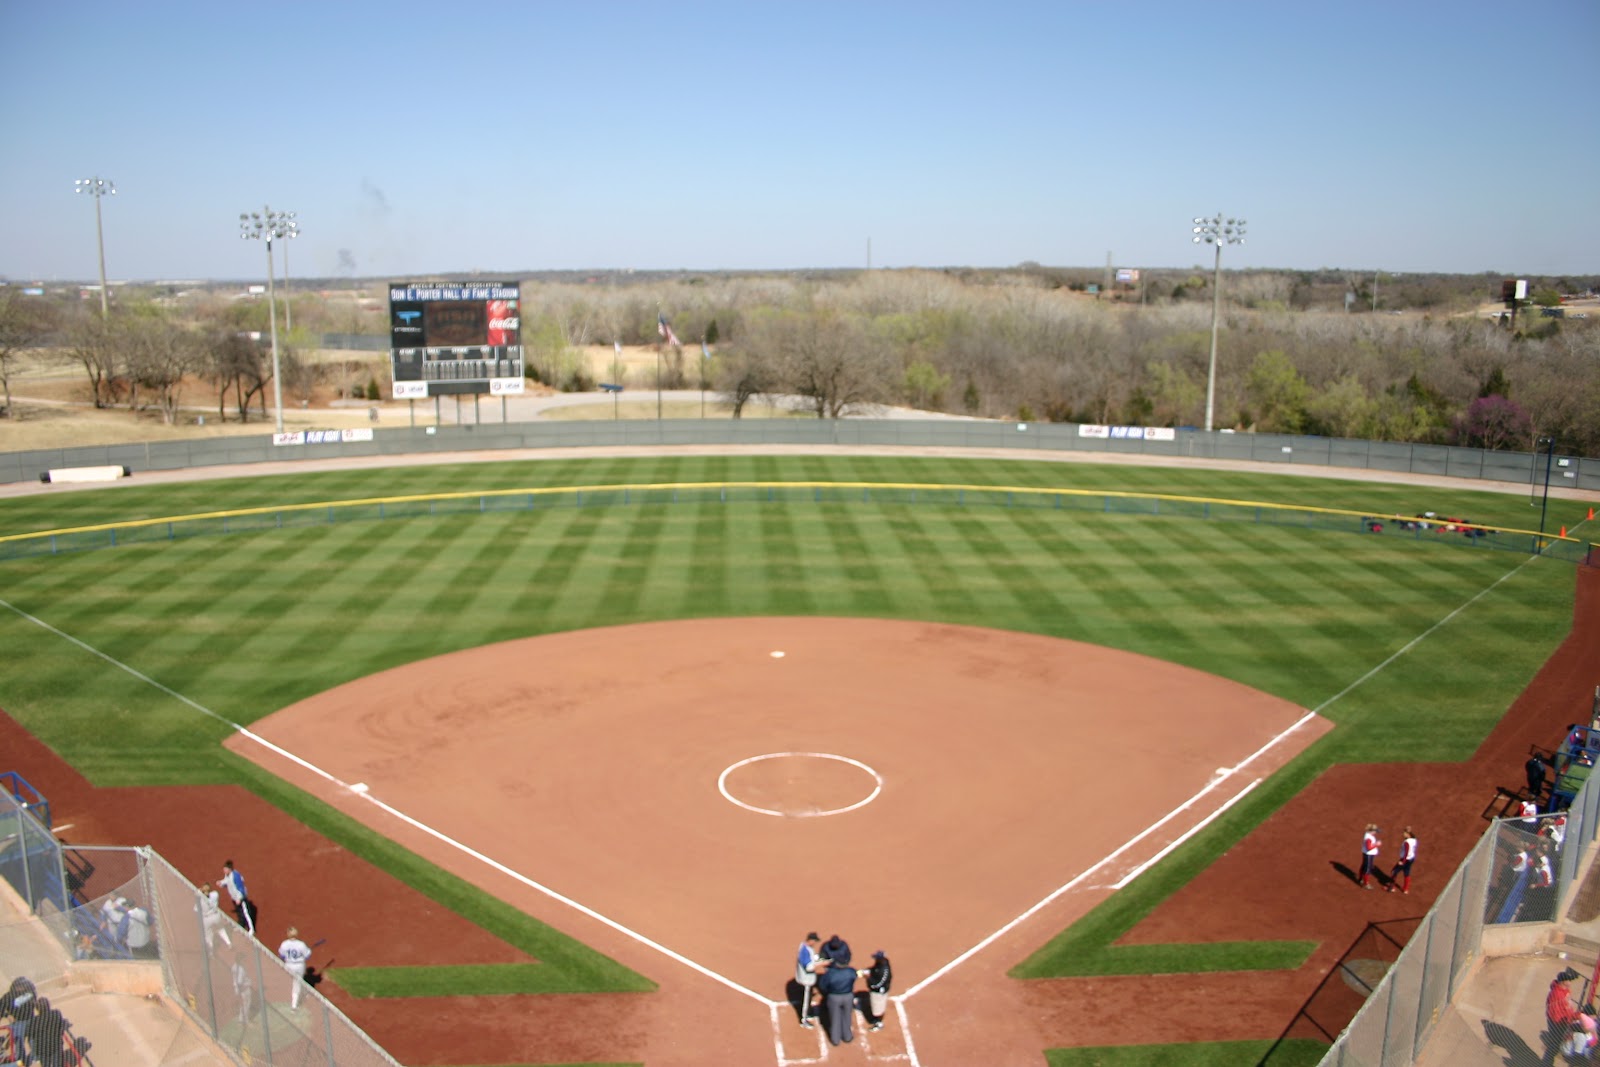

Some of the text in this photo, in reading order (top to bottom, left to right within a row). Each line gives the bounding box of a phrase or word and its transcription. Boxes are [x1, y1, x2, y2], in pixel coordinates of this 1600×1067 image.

[416, 289, 441, 300] PORTER
[442, 288, 460, 300] HALL
[461, 288, 470, 299] OF
[472, 288, 489, 299] FAME
[491, 287, 518, 299] STADIUM
